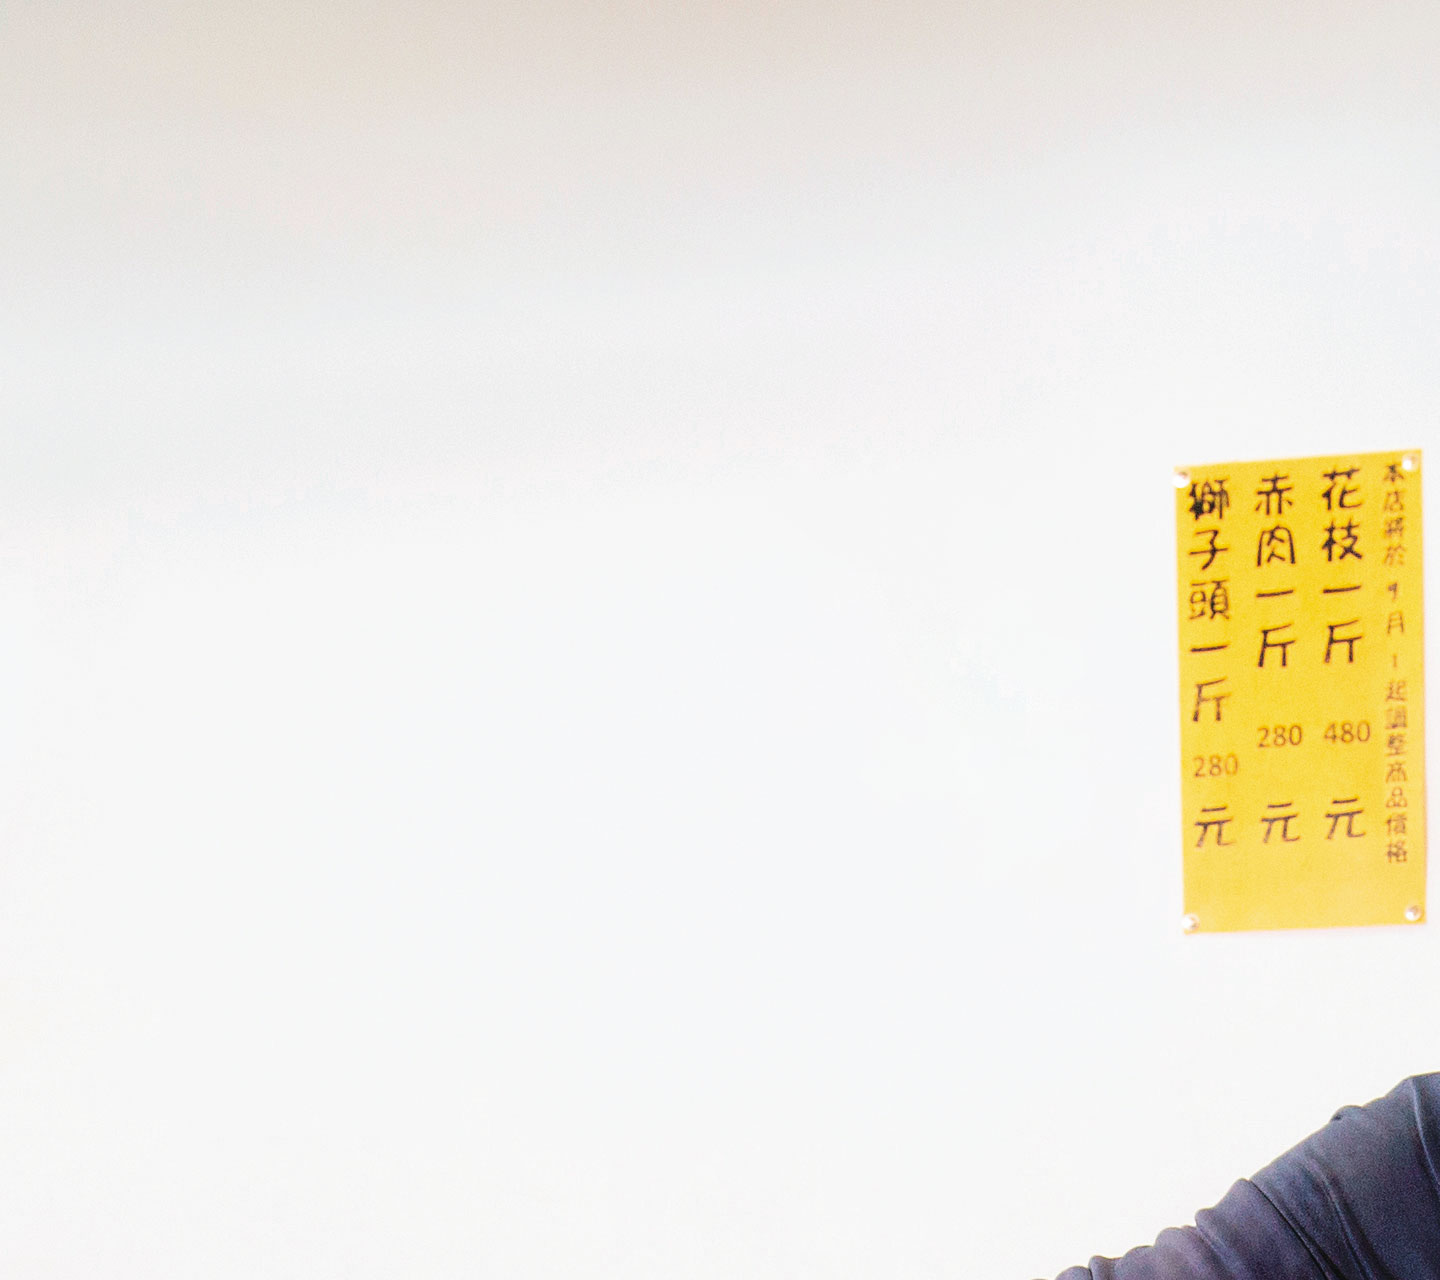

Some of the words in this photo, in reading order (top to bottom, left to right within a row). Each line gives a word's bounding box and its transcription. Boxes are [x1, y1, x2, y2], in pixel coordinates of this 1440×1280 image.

[1254, 471, 1298, 669] 赤肉一斤
[1322, 466, 1363, 664] 花枝一斤
[1187, 477, 1231, 724] 獅子頭一斤
[1257, 725, 1303, 749] 280
[1324, 720, 1371, 745] 480
[1192, 754, 1240, 780] 280
[1195, 806, 1234, 849] 元
[1260, 803, 1300, 844] 元
[1325, 798, 1365, 840] 元
